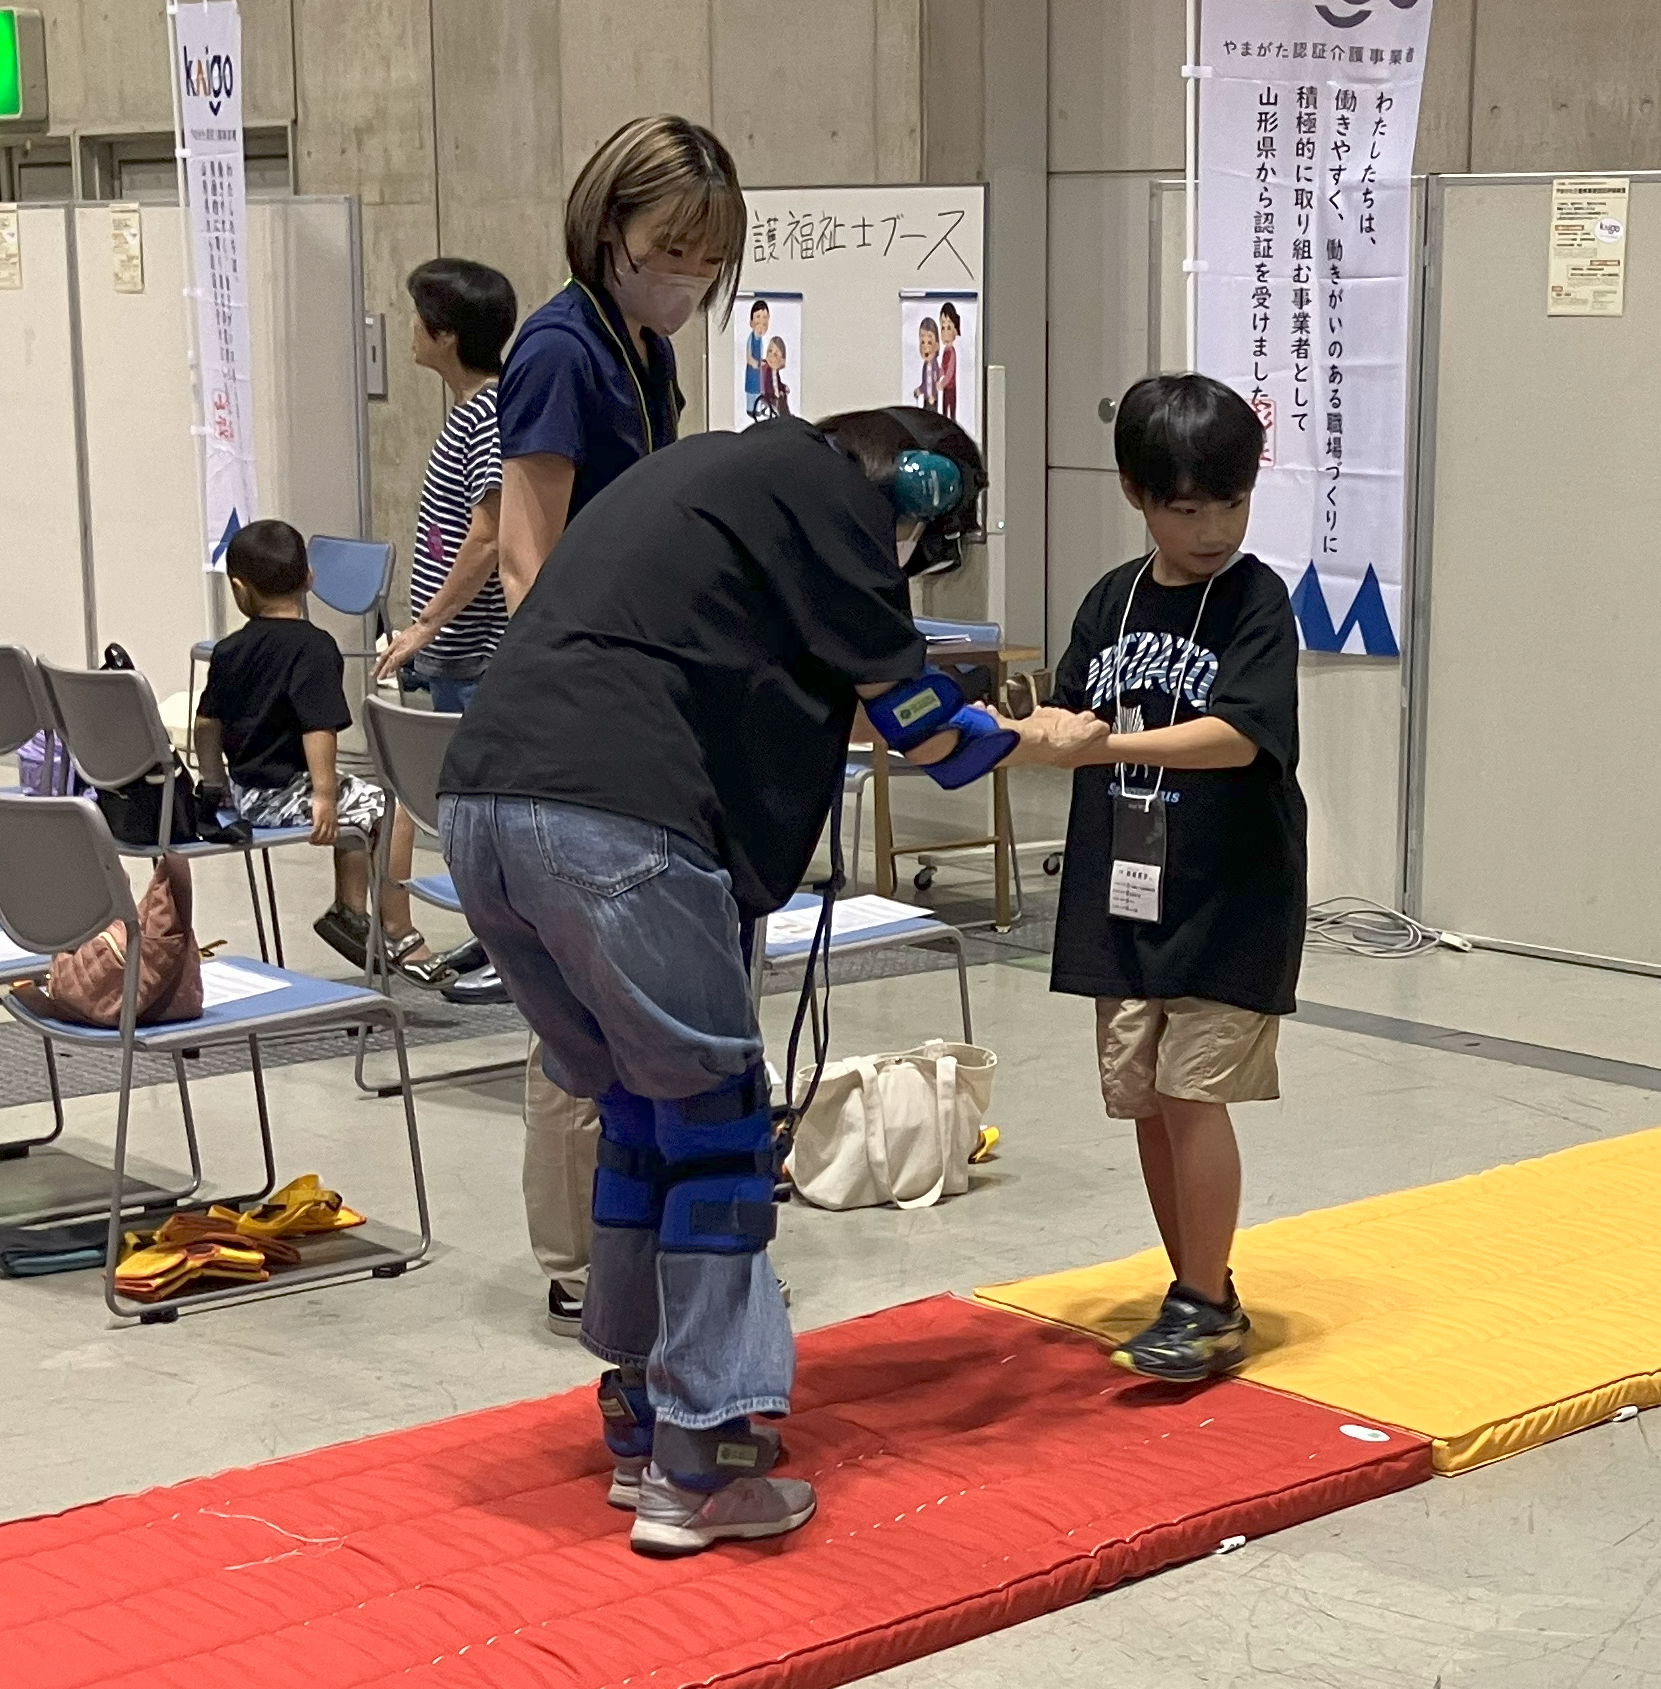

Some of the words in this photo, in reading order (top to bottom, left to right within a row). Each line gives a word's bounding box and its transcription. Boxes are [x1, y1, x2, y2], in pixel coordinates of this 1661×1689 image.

[752, 210, 975, 280] 護福祉士ブース
[1251, 86, 1279, 412] 山形県から認証を受けました
[1291, 86, 1318, 432] 積極的に取り組む事業者として
[1359, 91, 1394, 245] わたしたちは、
